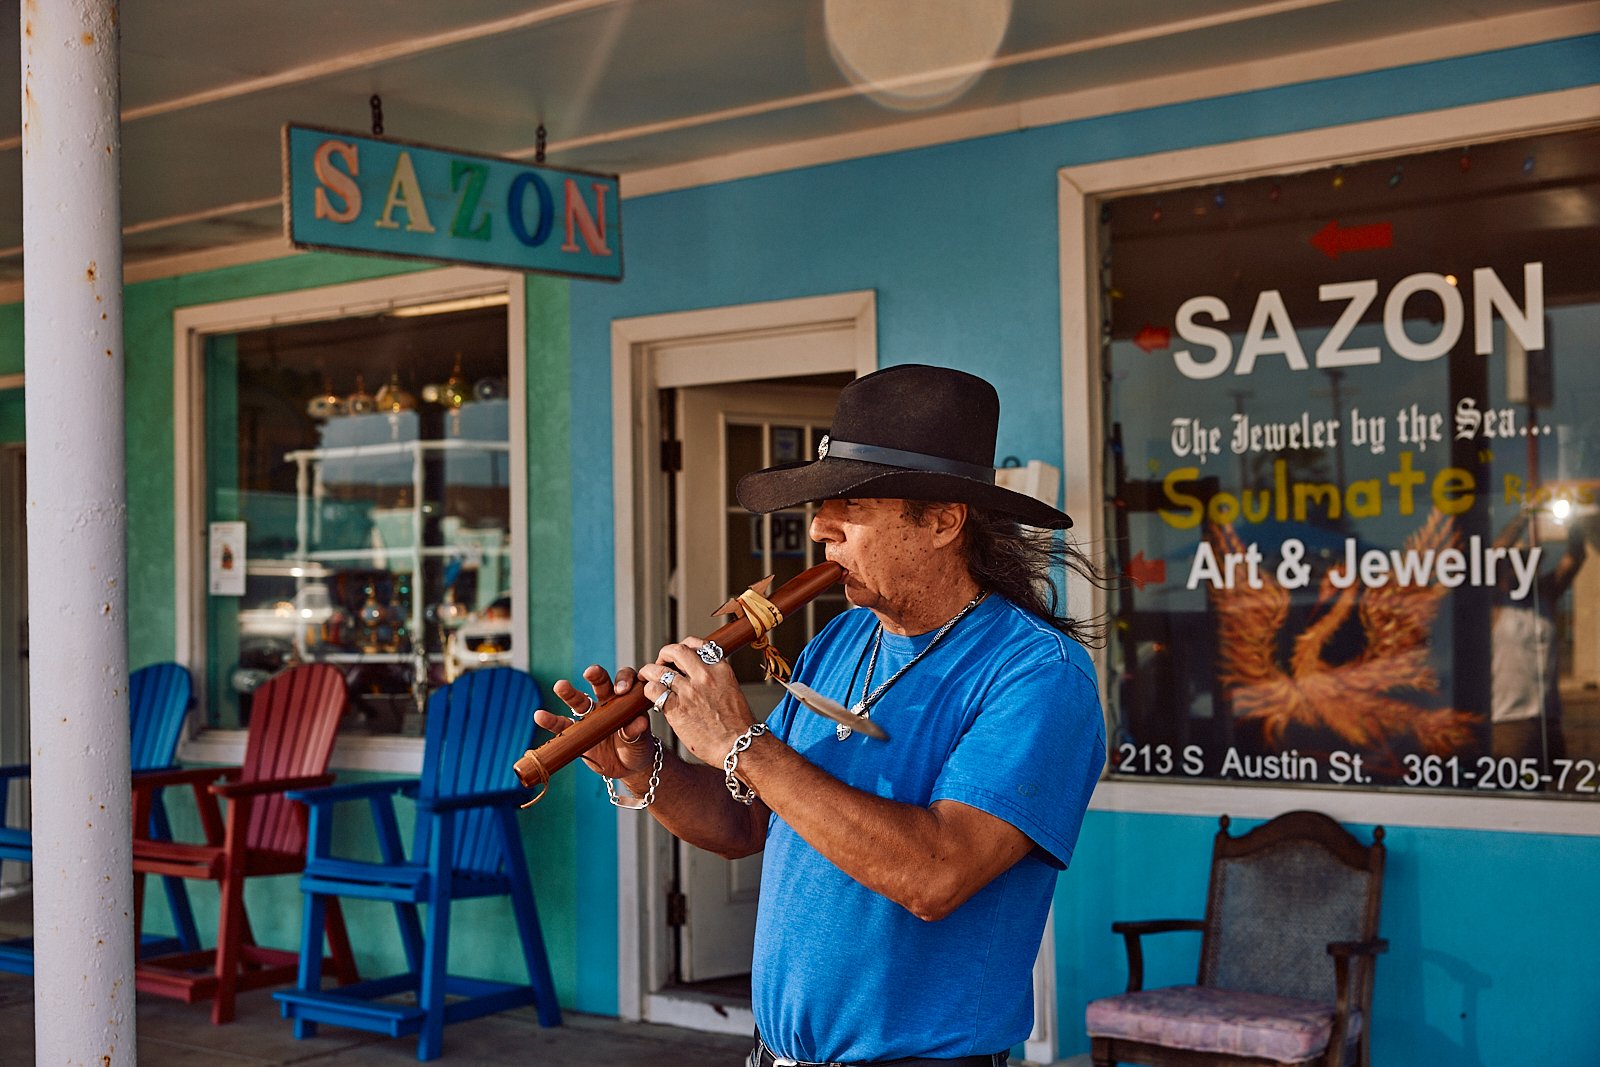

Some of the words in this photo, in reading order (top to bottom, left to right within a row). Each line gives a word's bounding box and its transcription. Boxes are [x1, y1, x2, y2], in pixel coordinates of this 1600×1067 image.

[313, 140, 613, 256] SAZON
[1173, 261, 1545, 380] SAZON
[1170, 416, 1221, 464] The
[1230, 411, 1340, 455] Jeweler
[1350, 407, 1386, 454] by
[1397, 403, 1444, 452] the
[1454, 397, 1551, 441] Sea...
[1186, 540, 1263, 590] Art
[1276, 538, 1311, 587] &
[1328, 535, 1542, 600] Jewelry
[1119, 743, 1173, 774] 213
[1182, 745, 1204, 775] S
[1220, 747, 1317, 781] Austin
[1328, 750, 1372, 783] St.
[1402, 754, 1600, 792] 361-205-72
